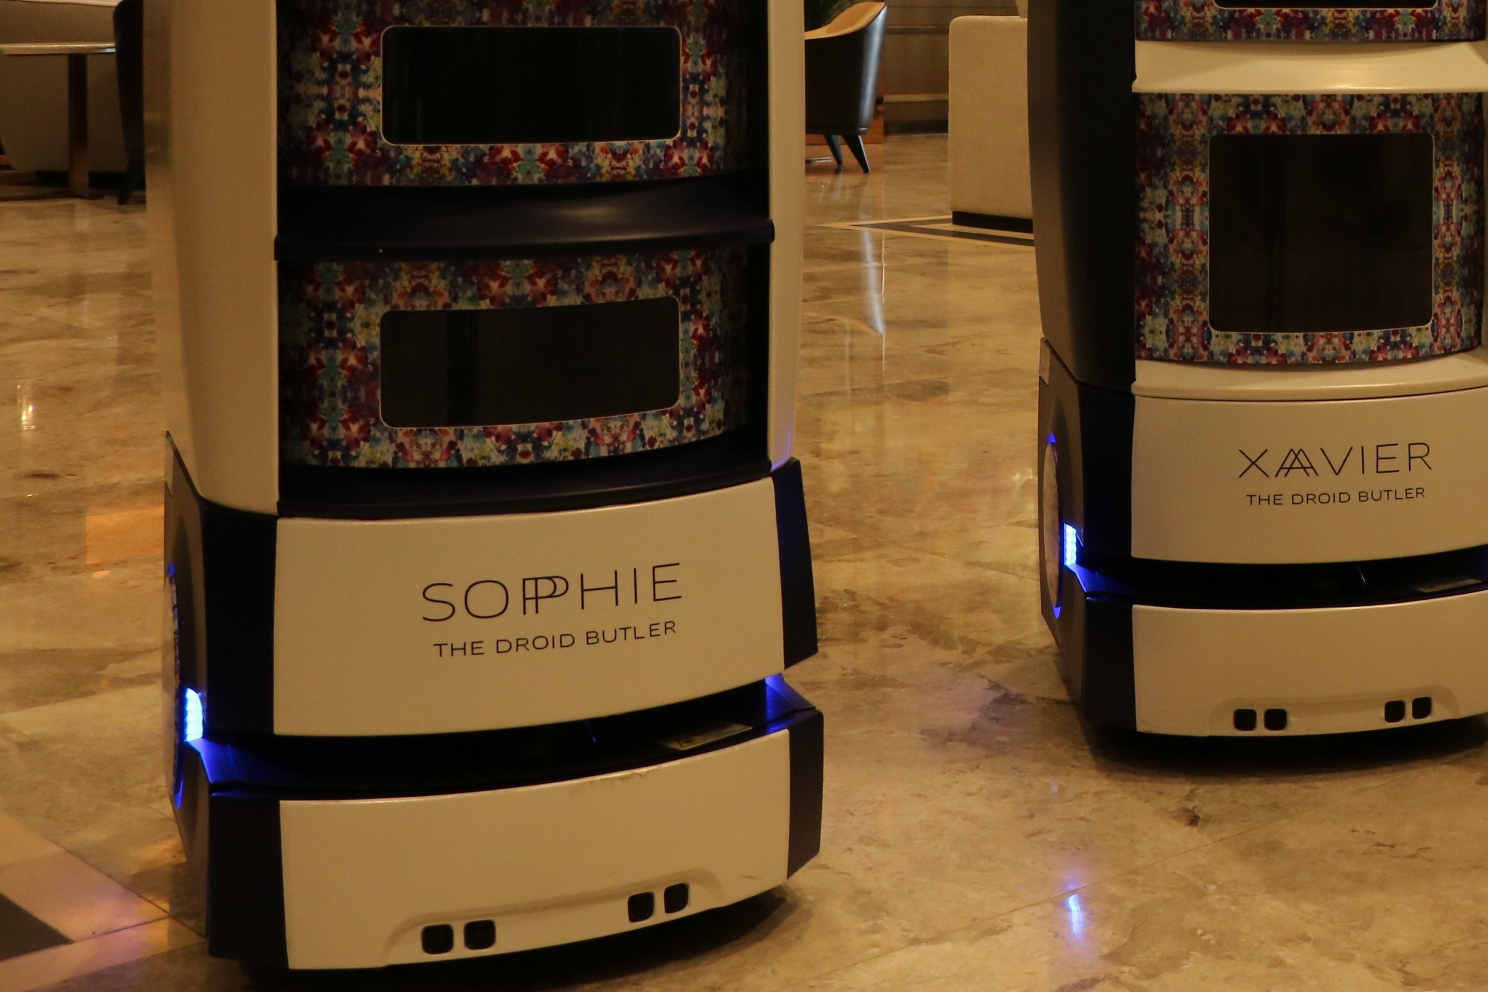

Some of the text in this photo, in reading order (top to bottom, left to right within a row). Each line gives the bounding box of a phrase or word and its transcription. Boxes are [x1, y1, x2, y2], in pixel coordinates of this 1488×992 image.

[1246, 487, 1425, 506] THE DROID BUTLER
[433, 620, 677, 658] THE DROID BUTLER
